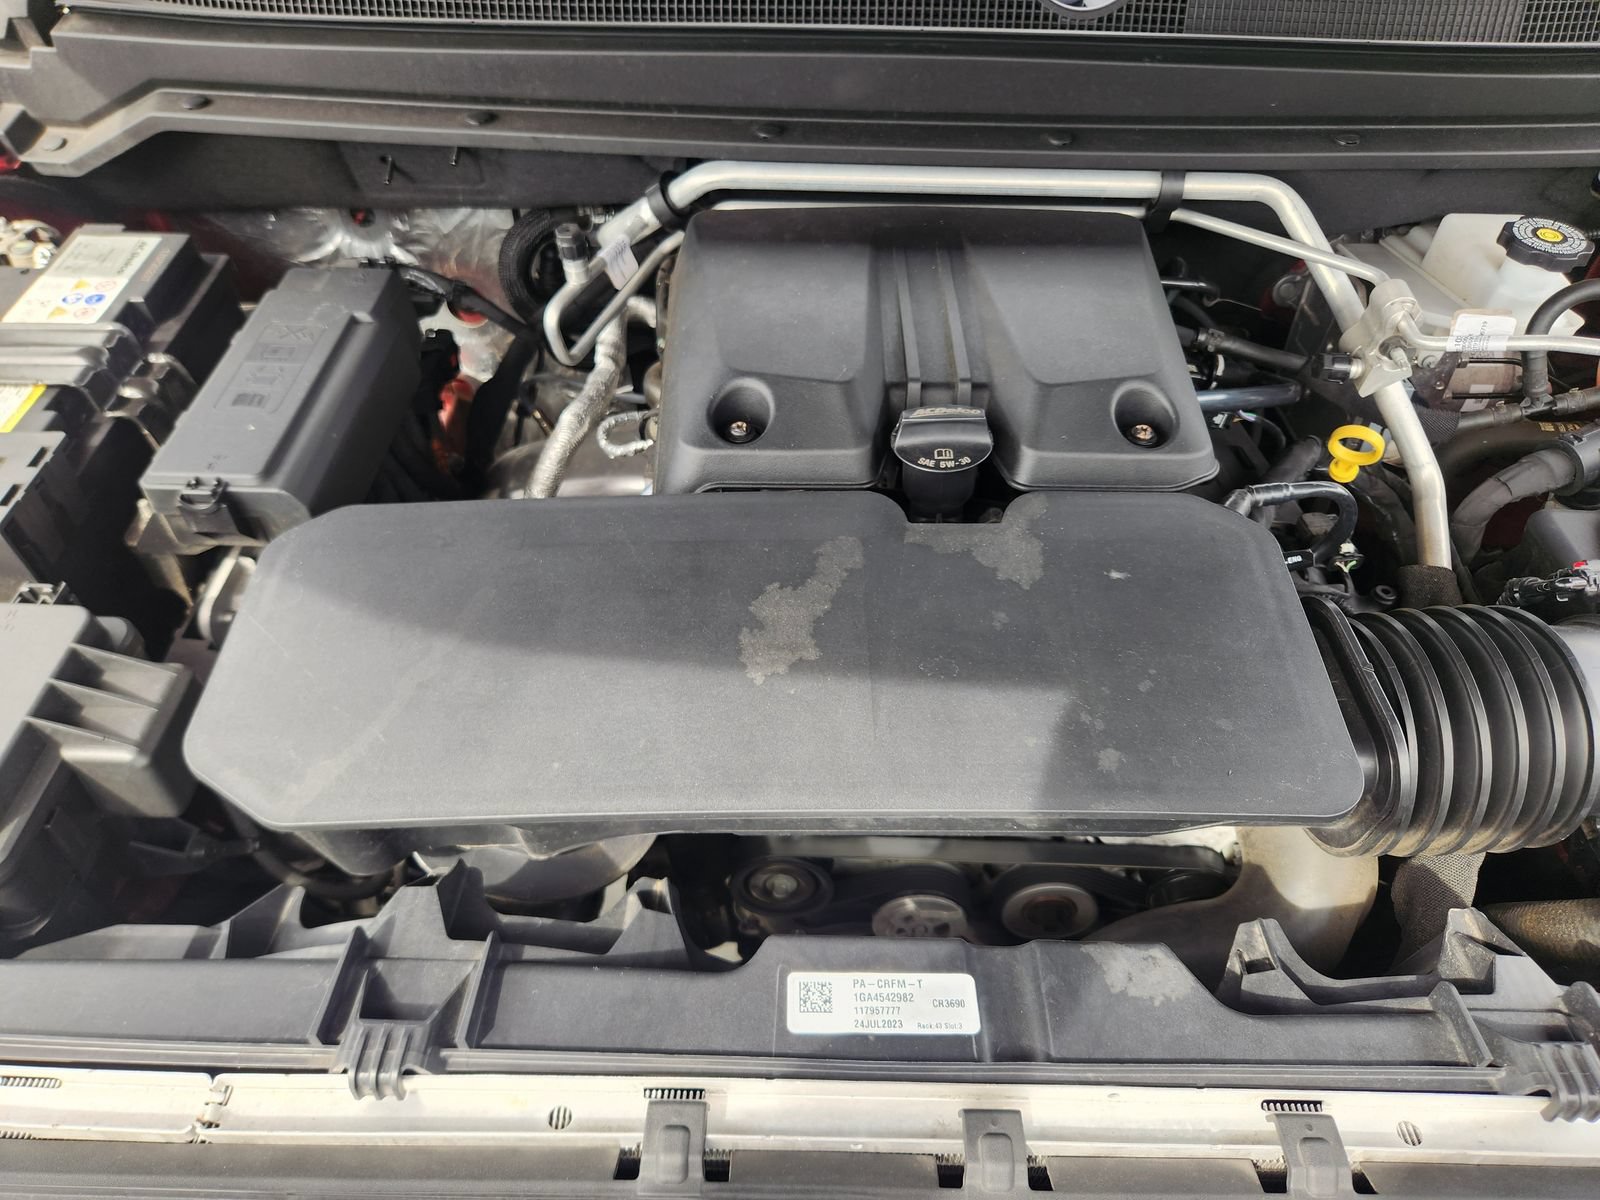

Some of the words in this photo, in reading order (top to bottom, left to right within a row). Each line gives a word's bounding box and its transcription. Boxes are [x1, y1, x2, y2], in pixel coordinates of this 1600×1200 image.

[918, 457, 936, 467] SAE
[939, 456, 972, 468] 5W-30
[853, 992, 915, 1003] 1GA4542982
[932, 998, 966, 1009] CR3690
[853, 1006, 902, 1015] 117957777
[853, 1019, 904, 1029] 24JUL2023
